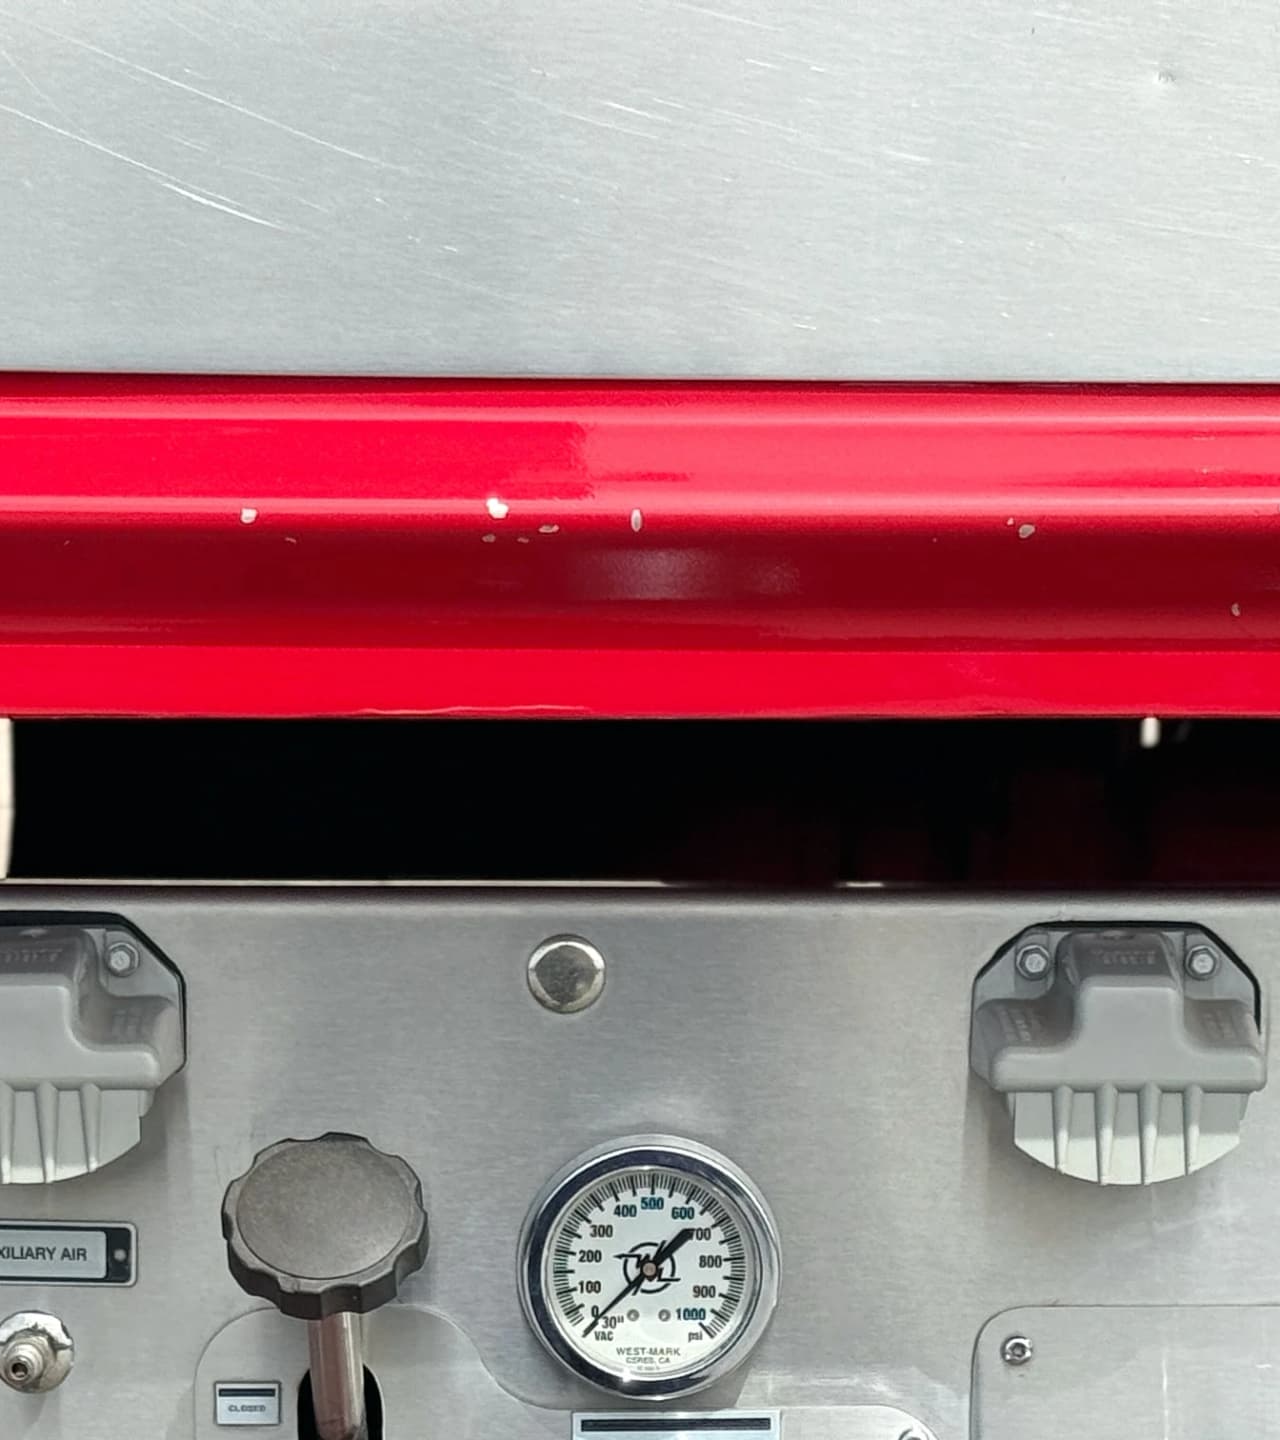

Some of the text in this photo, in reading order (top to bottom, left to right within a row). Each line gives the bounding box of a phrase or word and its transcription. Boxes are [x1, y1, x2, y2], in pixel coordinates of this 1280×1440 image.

[613, 1204, 637, 1217] 400
[640, 1197, 664, 1210] 500
[671, 1206, 695, 1219] 600
[589, 1224, 613, 1238] 300
[60, 1247, 88, 1261] AIR
[578, 1249, 602, 1263] 200
[699, 1254, 723, 1268] 800
[578, 1280, 602, 1294] 100
[692, 1285, 716, 1299] 900
[675, 1307, 706, 1321] 1000
[593, 1331, 615, 1342] VAC
[687, 1331, 704, 1343] psi
[615, 1347, 681, 1356] WEST-MARK
